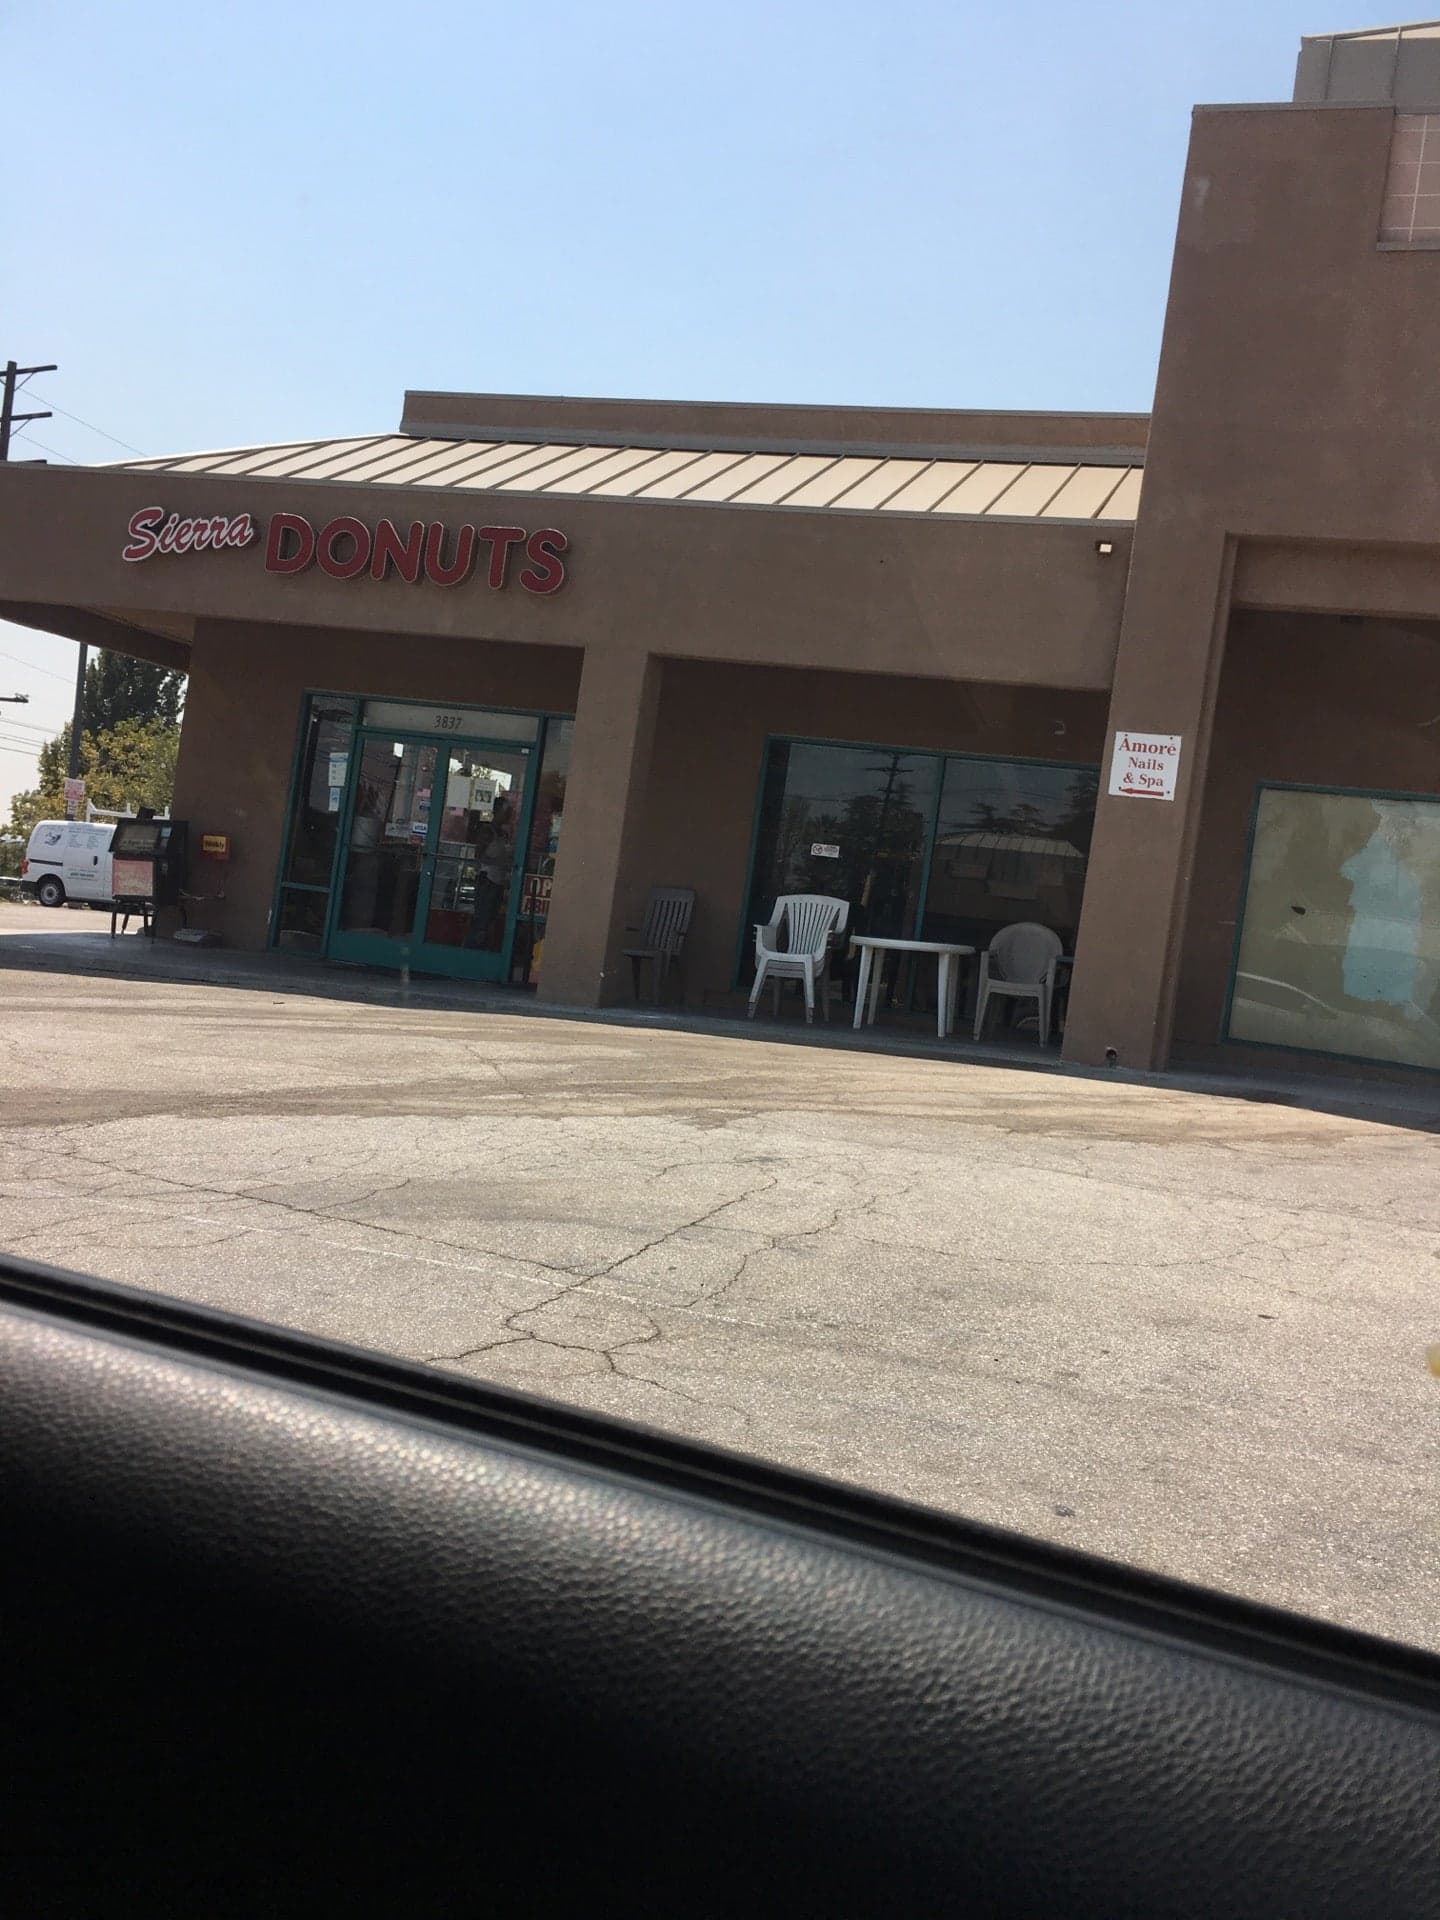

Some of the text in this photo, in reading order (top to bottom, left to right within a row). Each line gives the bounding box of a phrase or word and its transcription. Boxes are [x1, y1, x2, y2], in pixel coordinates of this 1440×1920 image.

[122, 506, 568, 594] Sierra DONUTS
[433, 715, 462, 729] 3837
[1119, 737, 1177, 756] Amore
[1128, 757, 1165, 771] Nails
[1123, 772, 1164, 788] & Spa
